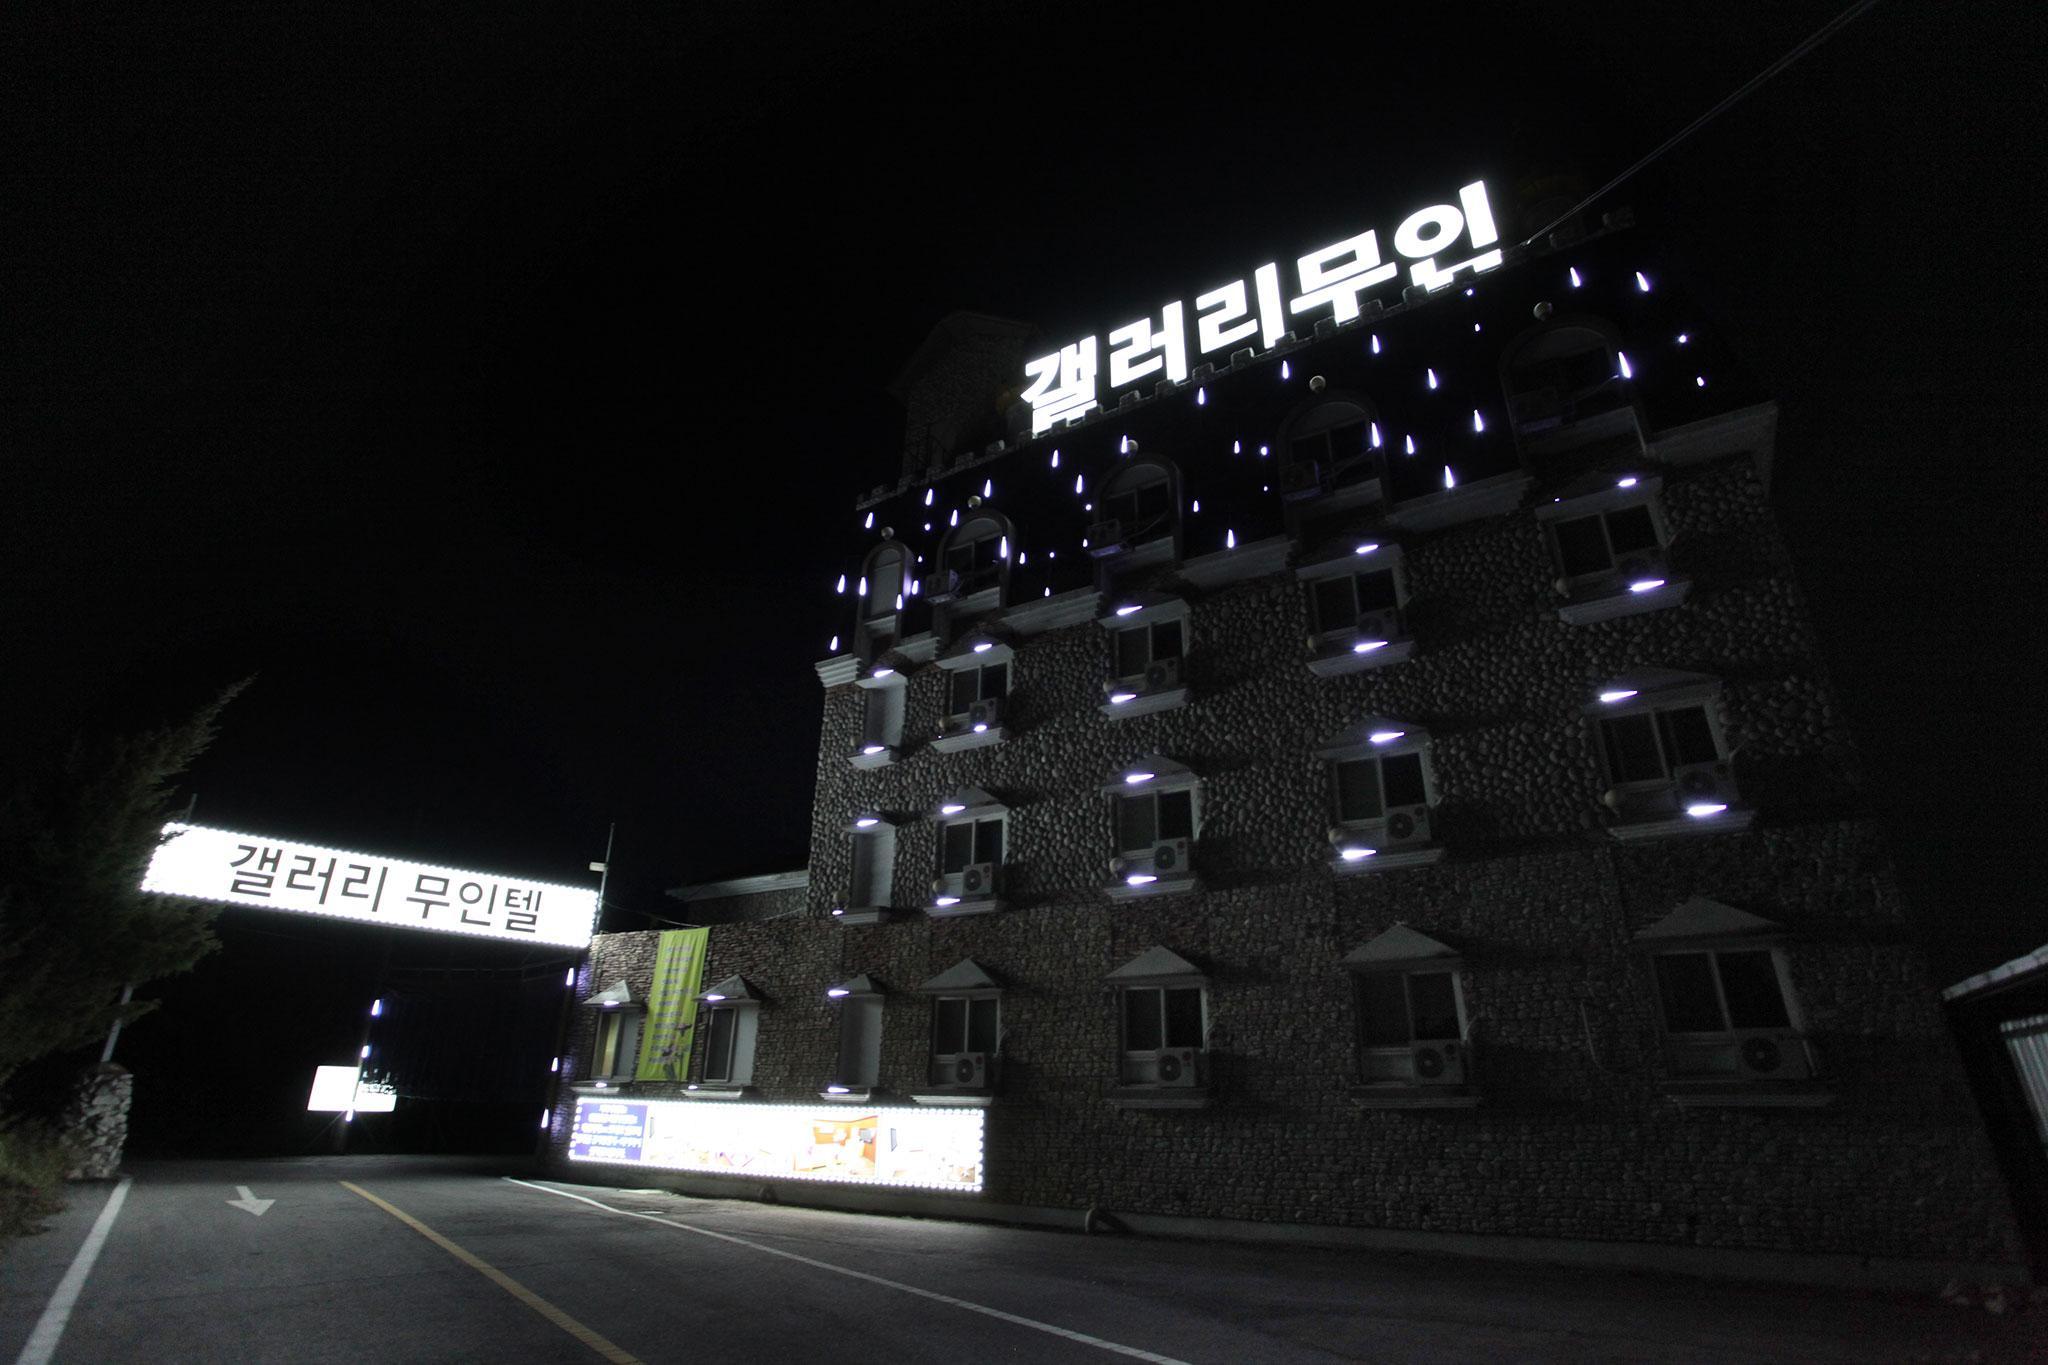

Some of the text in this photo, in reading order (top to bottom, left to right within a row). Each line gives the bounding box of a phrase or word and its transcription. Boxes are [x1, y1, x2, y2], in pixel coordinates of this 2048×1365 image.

[1020, 180, 1503, 437] 갤러리무인
[229, 843, 543, 933] 갤러리 무인텔
